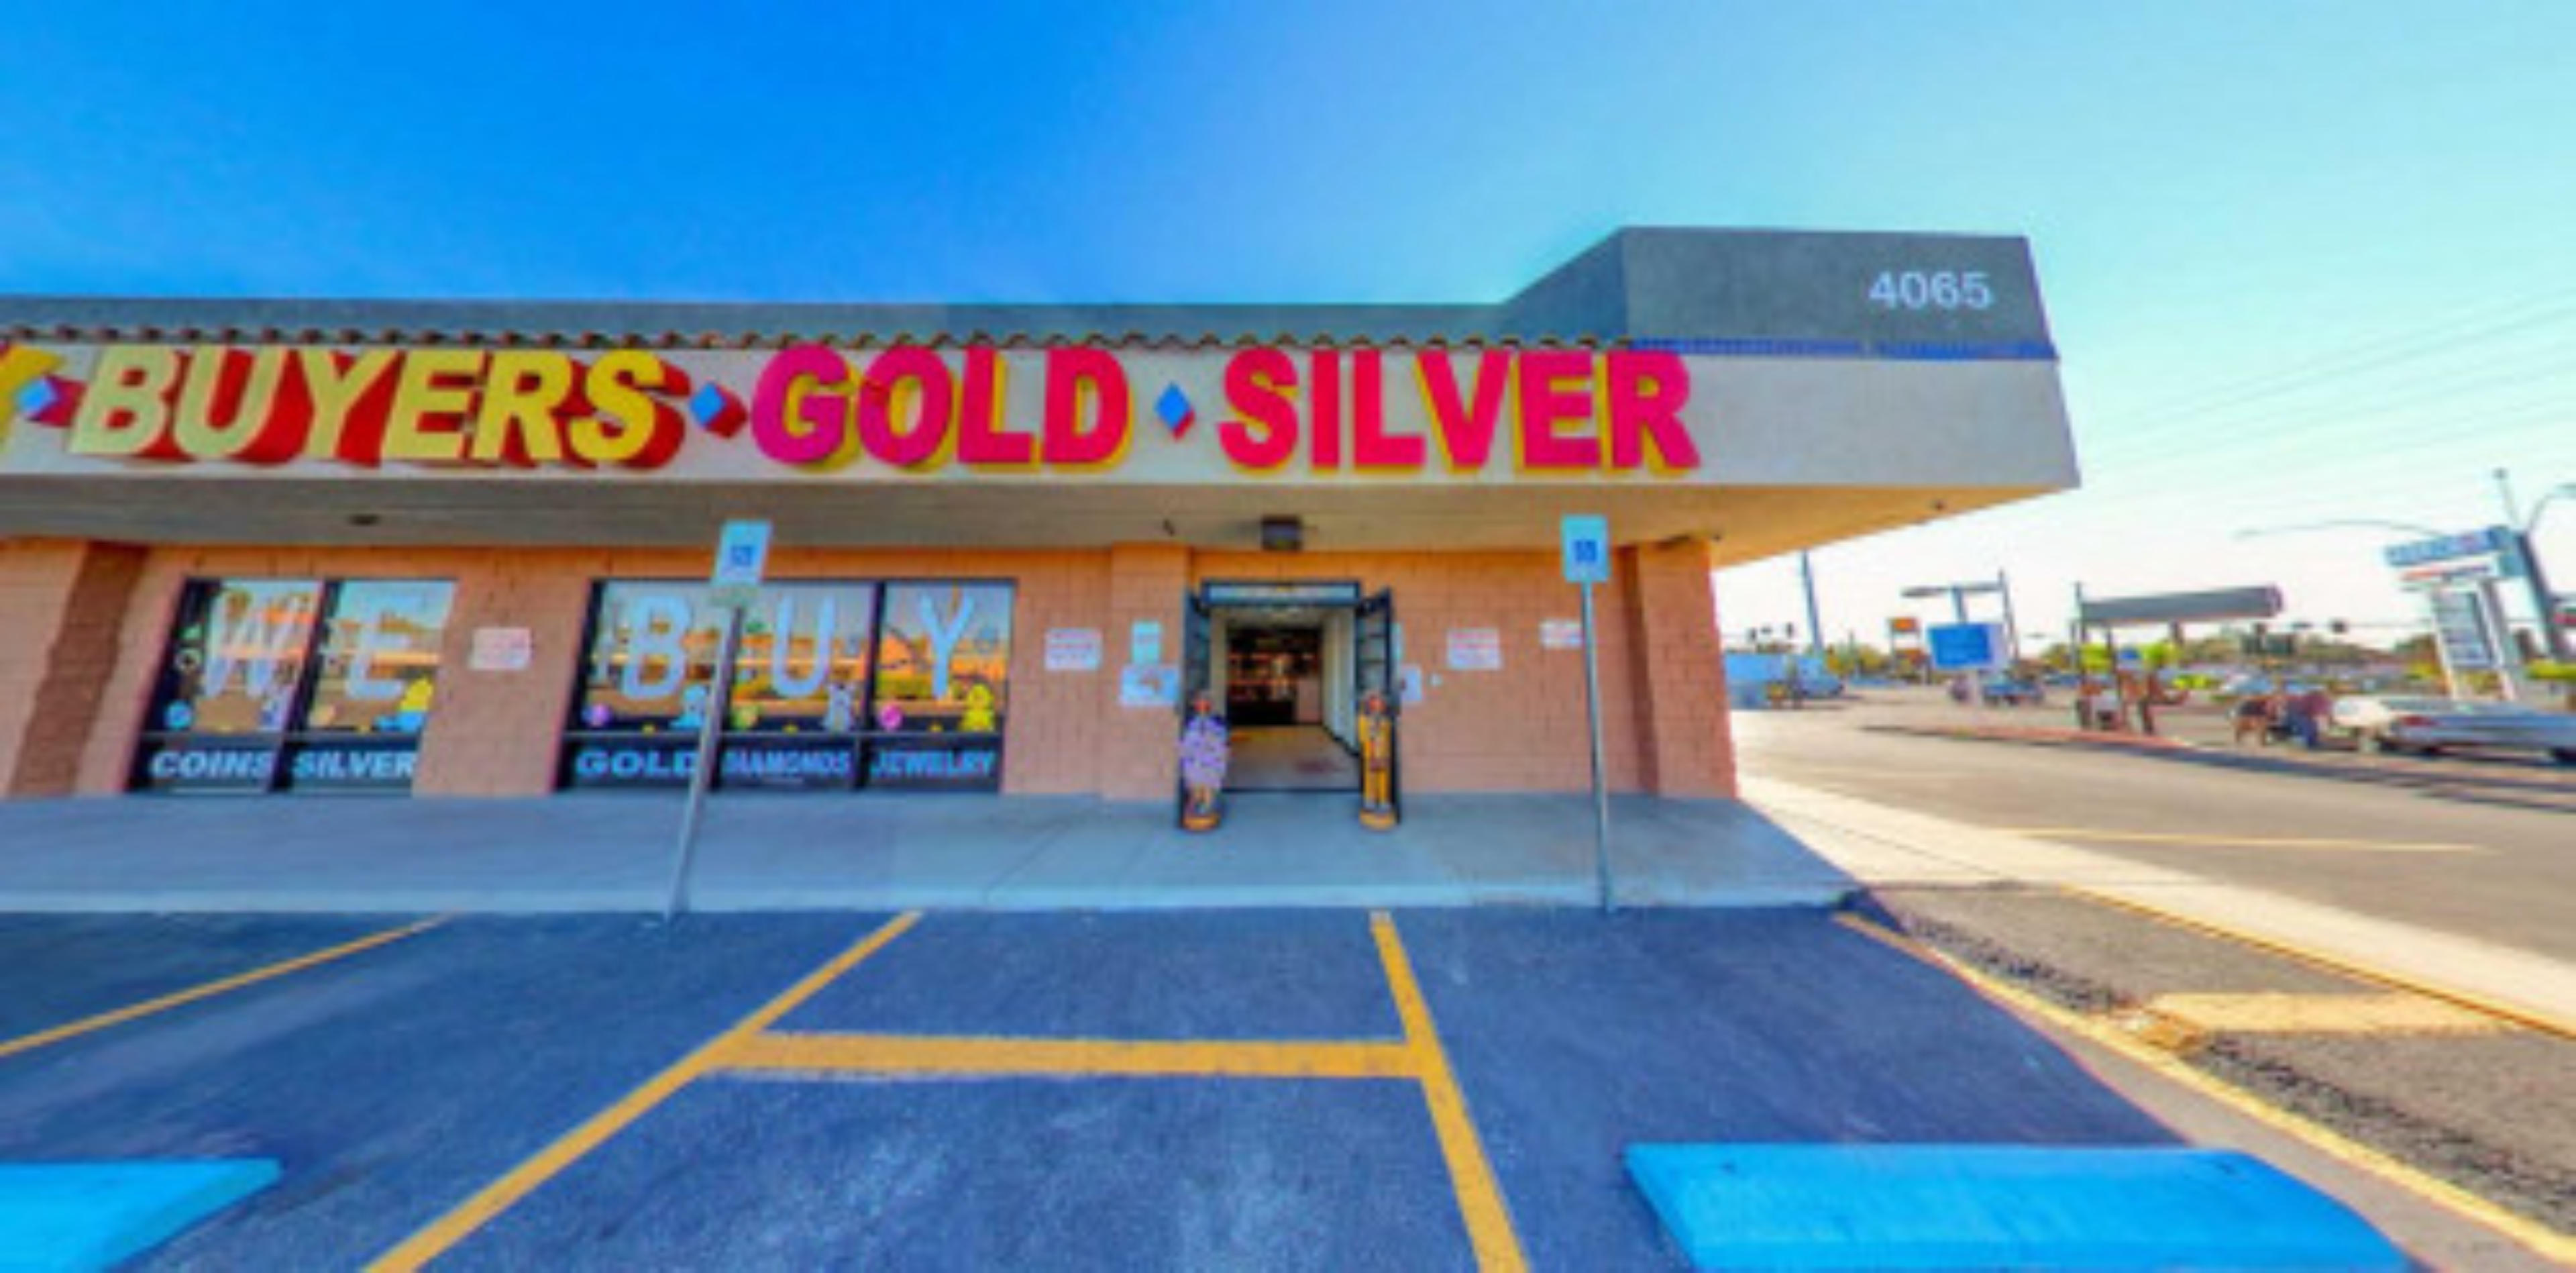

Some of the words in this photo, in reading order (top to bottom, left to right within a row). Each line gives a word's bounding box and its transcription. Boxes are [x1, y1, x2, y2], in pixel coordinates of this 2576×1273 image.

[1869, 271, 1994, 309] 4065
[67, 344, 679, 463] BUYERS
[750, 344, 1132, 468] GOLD
[1218, 346, 1701, 473] SILVER
[149, 750, 273, 780] COINS
[293, 750, 417, 780] SILVER
[576, 750, 700, 778] GOLD
[871, 750, 994, 778] JEWELRY
